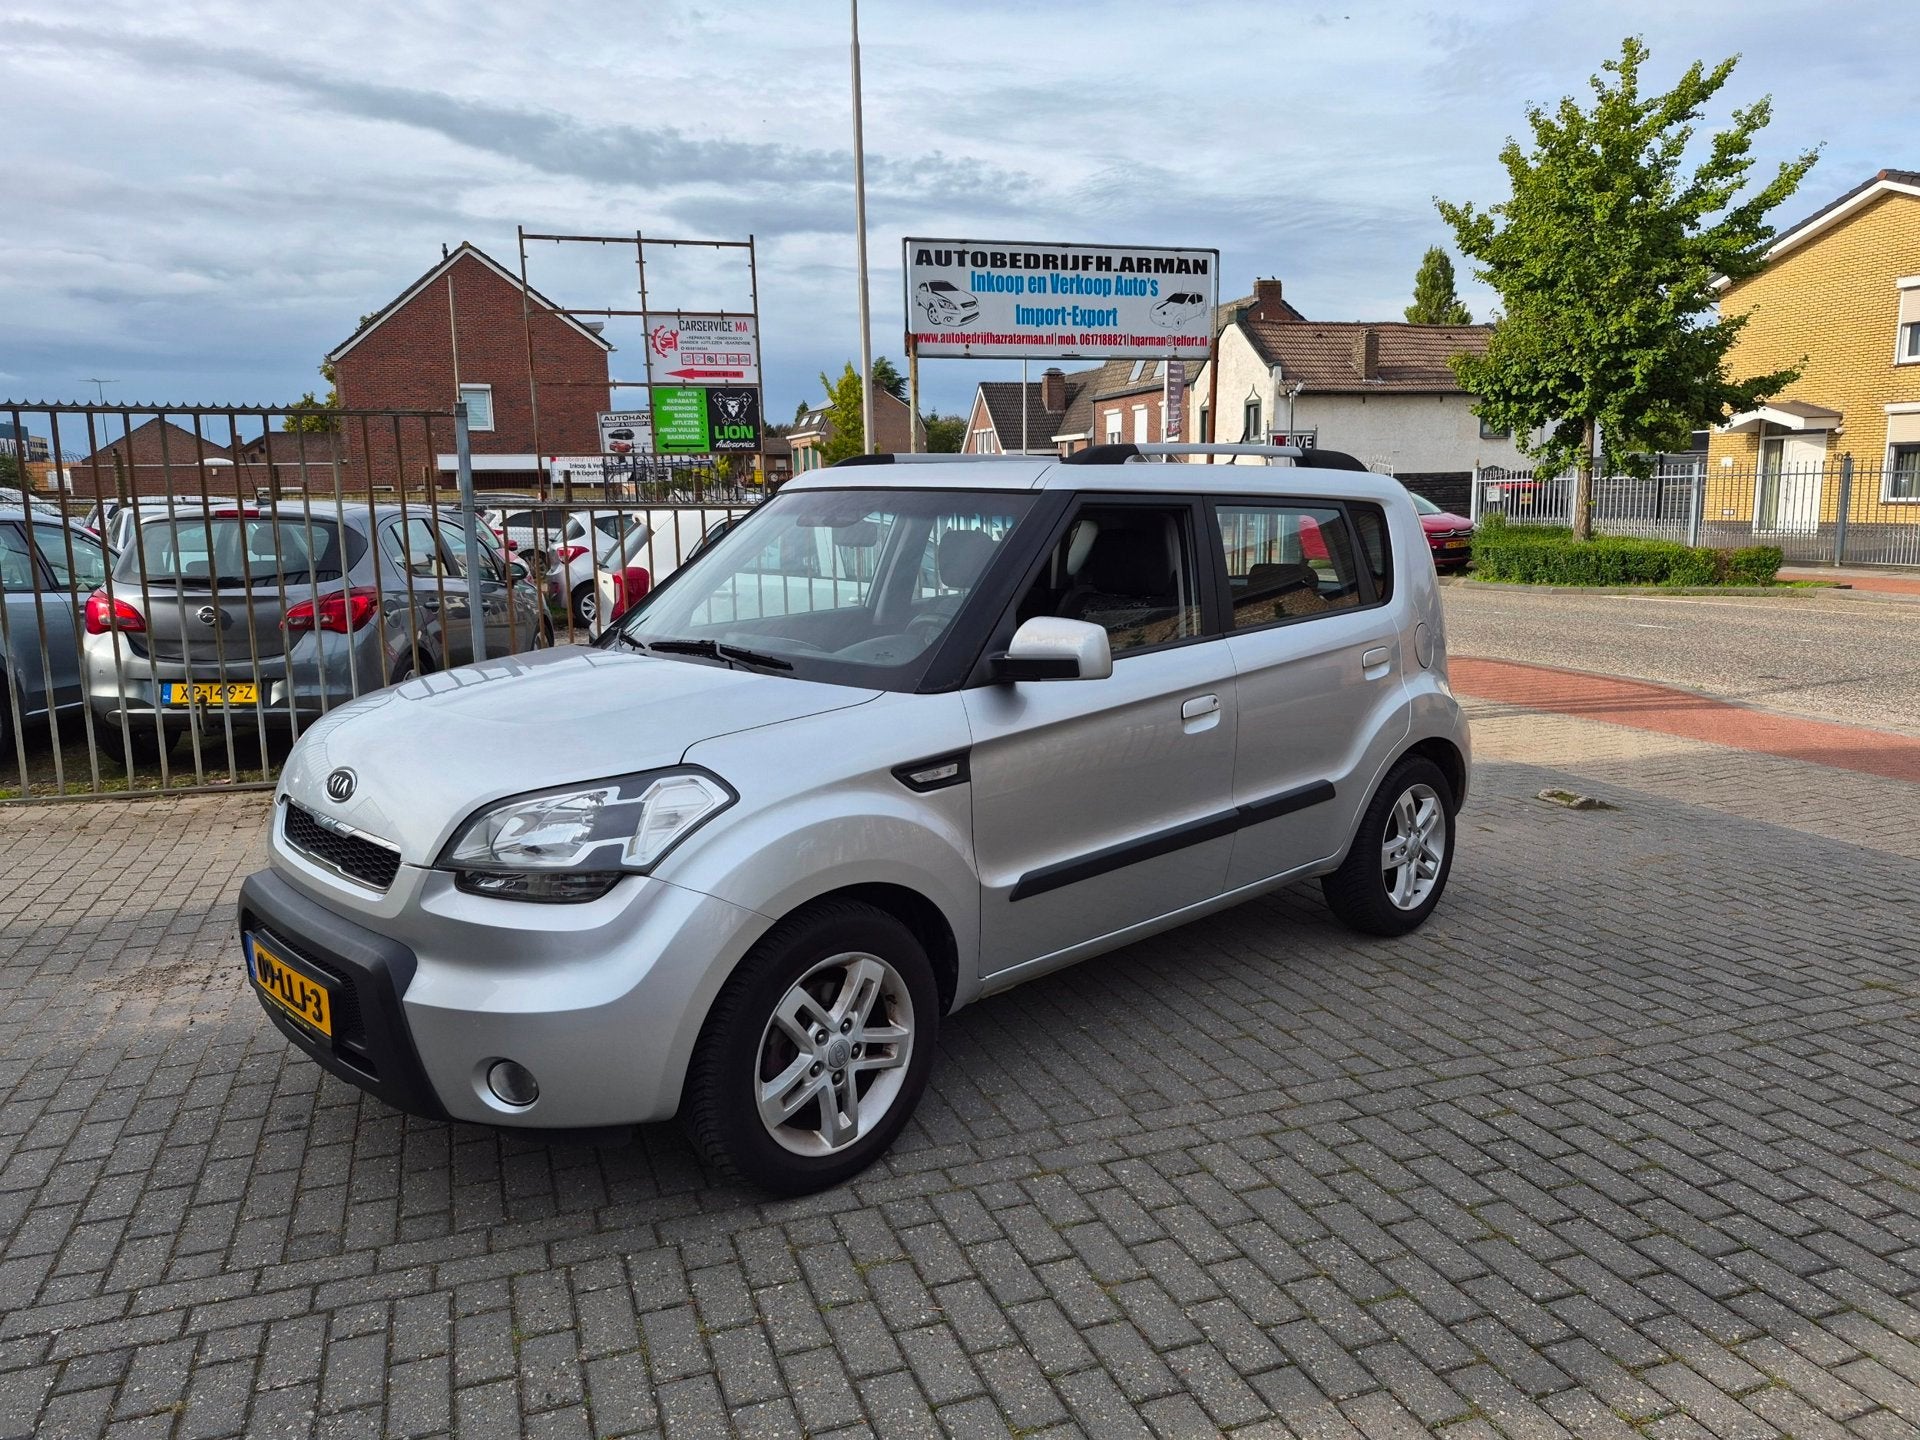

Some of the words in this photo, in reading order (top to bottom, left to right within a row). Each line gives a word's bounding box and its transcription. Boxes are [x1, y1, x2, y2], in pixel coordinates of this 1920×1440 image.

[915, 249, 1208, 275] AUTOBEDRIJFH.ARMAN
[971, 271, 1024, 295] Inkoop
[1028, 277, 1046, 294] en
[1051, 273, 1112, 297] Verkoop
[1115, 275, 1159, 297] Auto's
[1015, 304, 1118, 328] Import-Export
[679, 320, 733, 332] CARSERVICE
[735, 321, 748, 333] MA
[714, 425, 754, 439] LION
[715, 440, 755, 448] Autoservice
